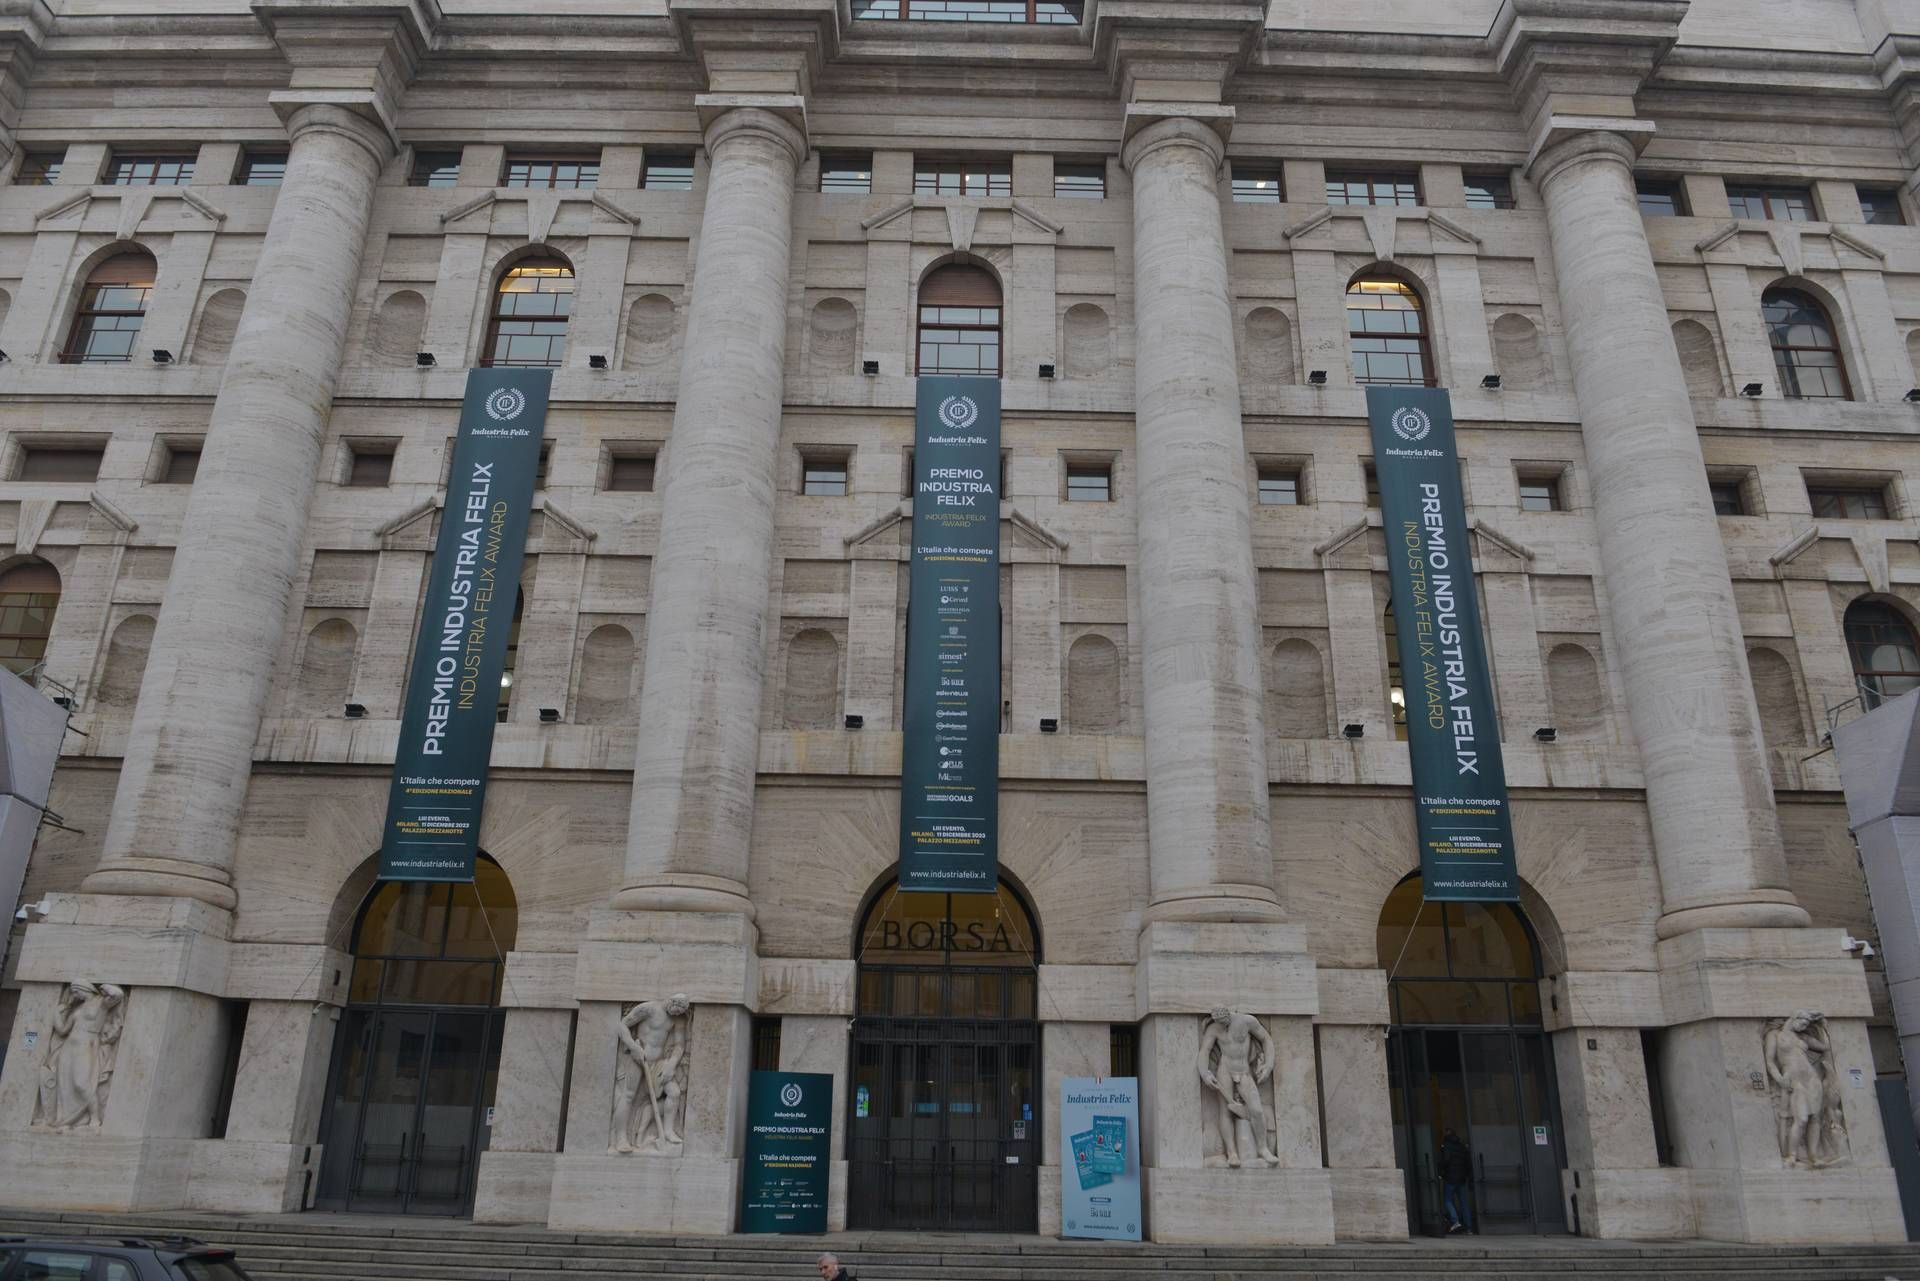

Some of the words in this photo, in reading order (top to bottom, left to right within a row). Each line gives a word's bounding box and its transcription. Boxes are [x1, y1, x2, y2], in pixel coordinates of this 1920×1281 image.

[471, 428, 508, 436] Industria
[920, 482, 993, 493] INDUSTRIA
[930, 468, 983, 480] PREMIO
[937, 495, 976, 506] FELIX
[484, 501, 507, 563] AWARD
[1420, 483, 1449, 570] PREMIO
[1403, 521, 1428, 607] INDUSTRIA
[423, 656, 457, 755] PREMIO
[440, 528, 482, 651] INDUSTRIA
[464, 462, 494, 523] FELIX
[474, 567, 497, 612] FELIX
[1416, 611, 1435, 657] FELIX
[1432, 574, 1468, 701] INDUSTRIA
[457, 616, 487, 709] INDUSTRIA
[1422, 661, 1445, 730] AWARD
[1451, 706, 1480, 776] FELIX
[400, 776, 426, 785] L'Italia
[427, 777, 442, 785] che
[391, 860, 465, 868] www.industriafelix.it
[910, 870, 986, 879] www.industriafelix.it
[1434, 880, 1508, 888] www.industriafelix.it
[883, 920, 1012, 952] BORSA
[1067, 1094, 1107, 1103] Industria
[1109, 1094, 1131, 1104] Felix
